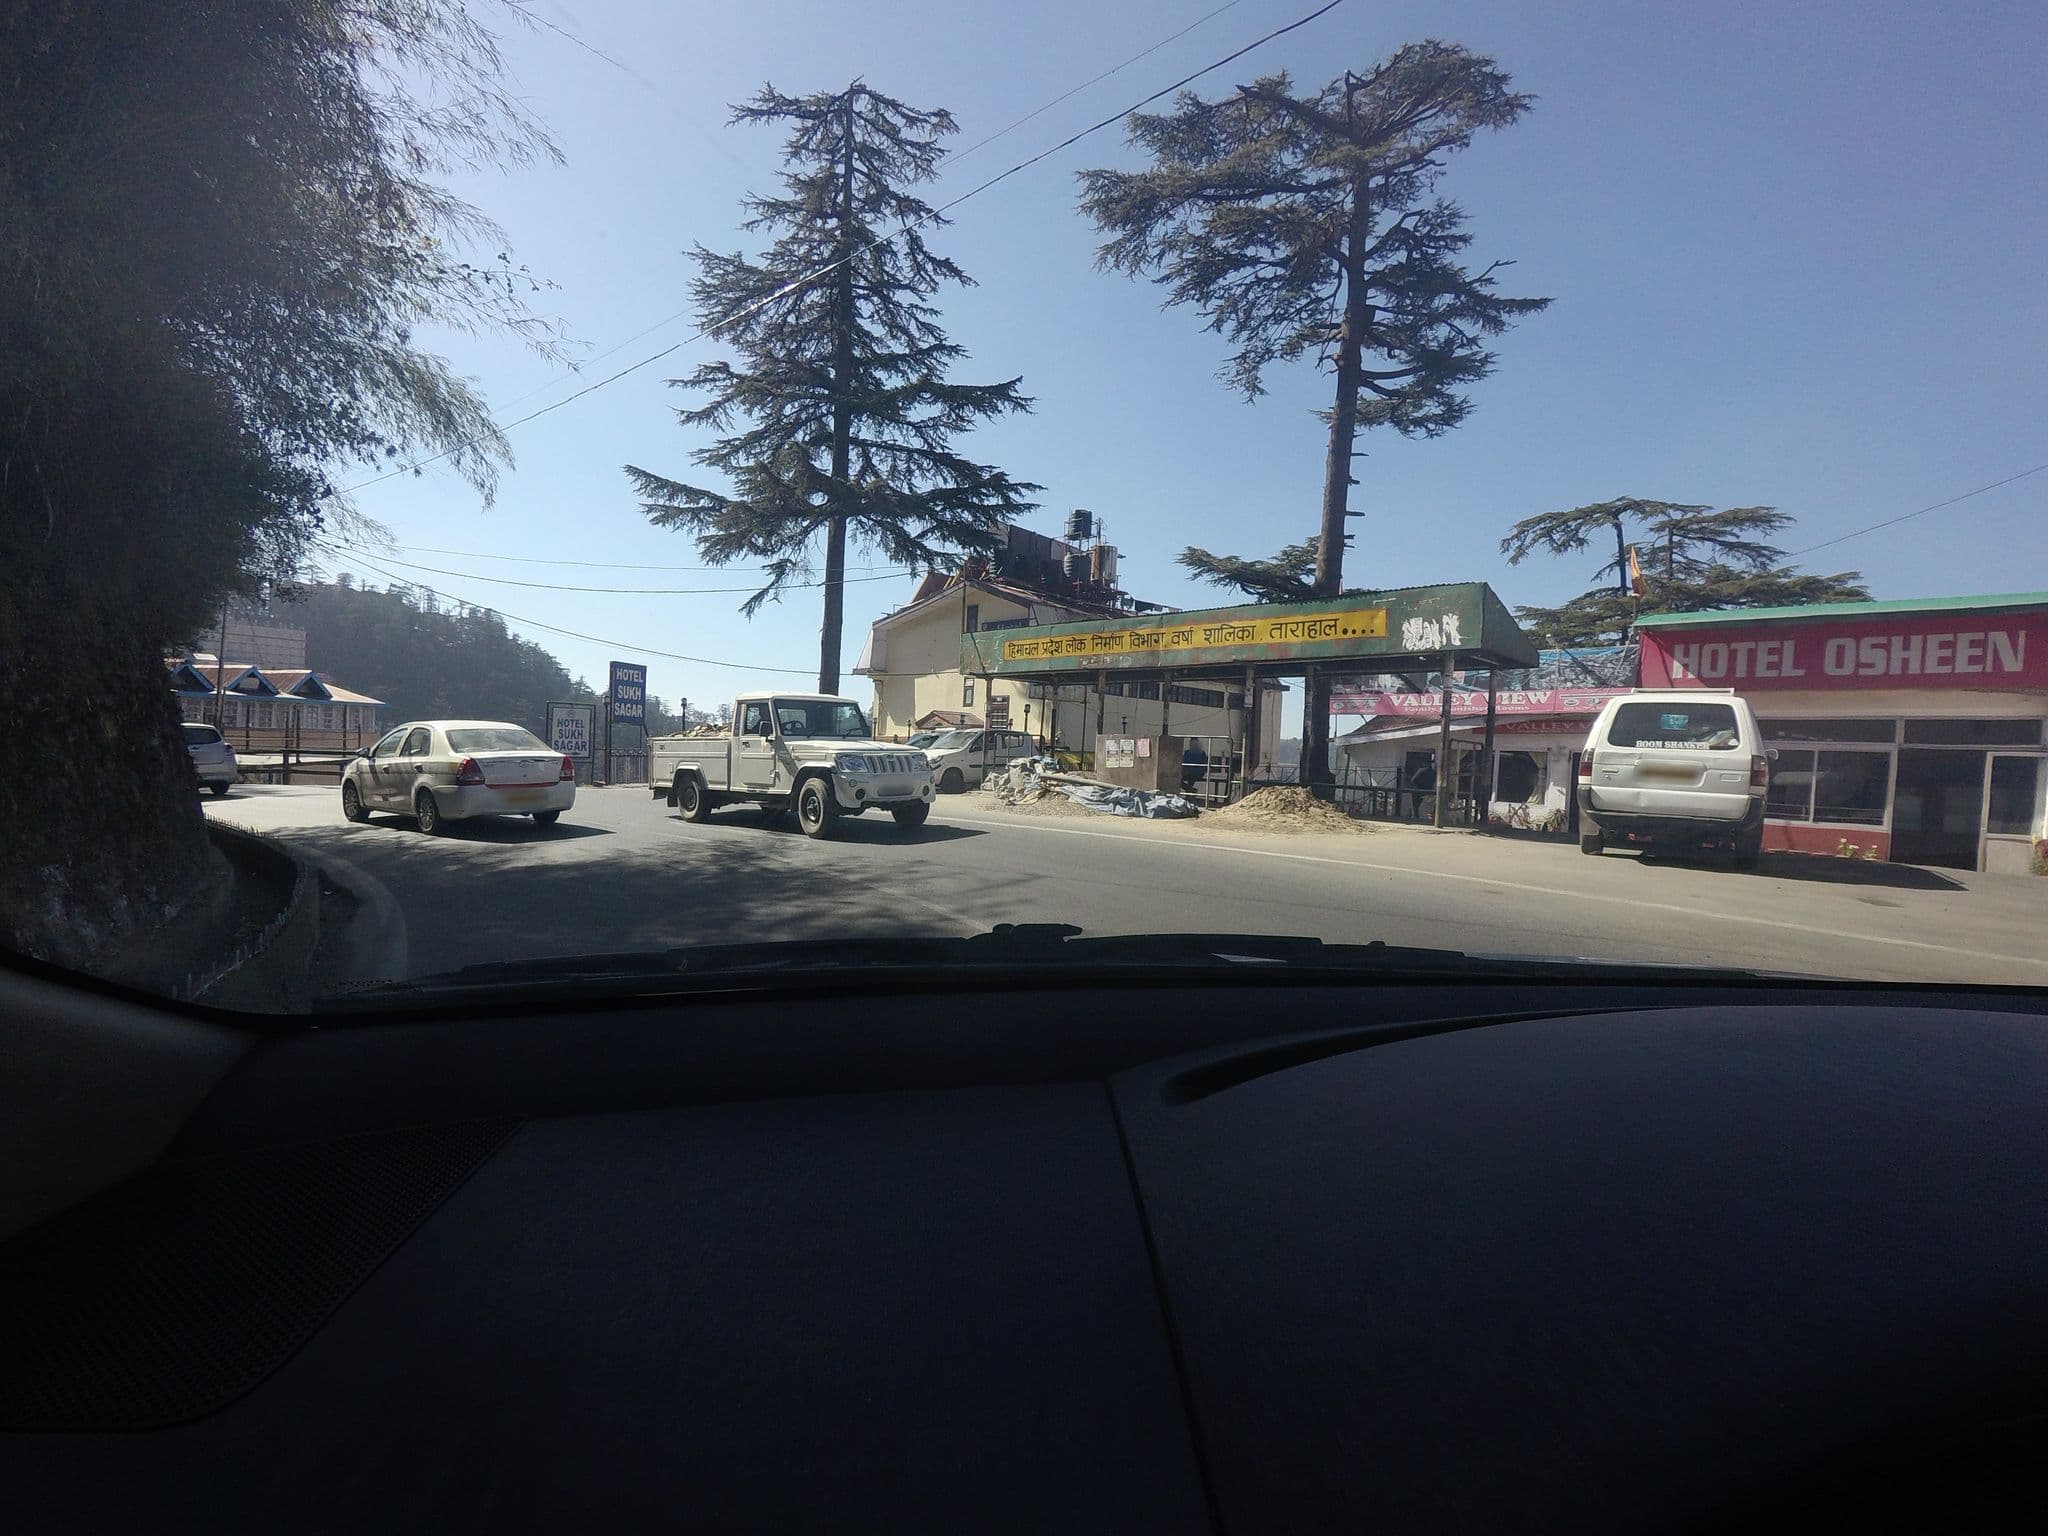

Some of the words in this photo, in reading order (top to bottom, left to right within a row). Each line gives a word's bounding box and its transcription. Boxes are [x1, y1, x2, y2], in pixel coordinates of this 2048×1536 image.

[1007, 641, 1039, 659] हिमाचल
[1041, 638, 1063, 656] प्रदेश
[1065, 637, 1088, 652] लोक
[1091, 633, 1124, 651] निर्माण
[1171, 627, 1194, 646] वर्षा
[1202, 624, 1257, 644] शालिका
[1672, 640, 1805, 679] HOTEL
[1824, 630, 2028, 676] OSHEEN
[616, 668, 643, 682] HOTEL
[617, 685, 642, 700] SUKH
[1388, 692, 1475, 706] VALLEY
[614, 702, 643, 718] SAGAR
[557, 718, 584, 728] HOTEL
[558, 728, 583, 739] SUKH
[553, 740, 587, 752] SAGAR
[1635, 740, 1662, 749] BOOM
[1664, 741, 1710, 750] SHANKER
